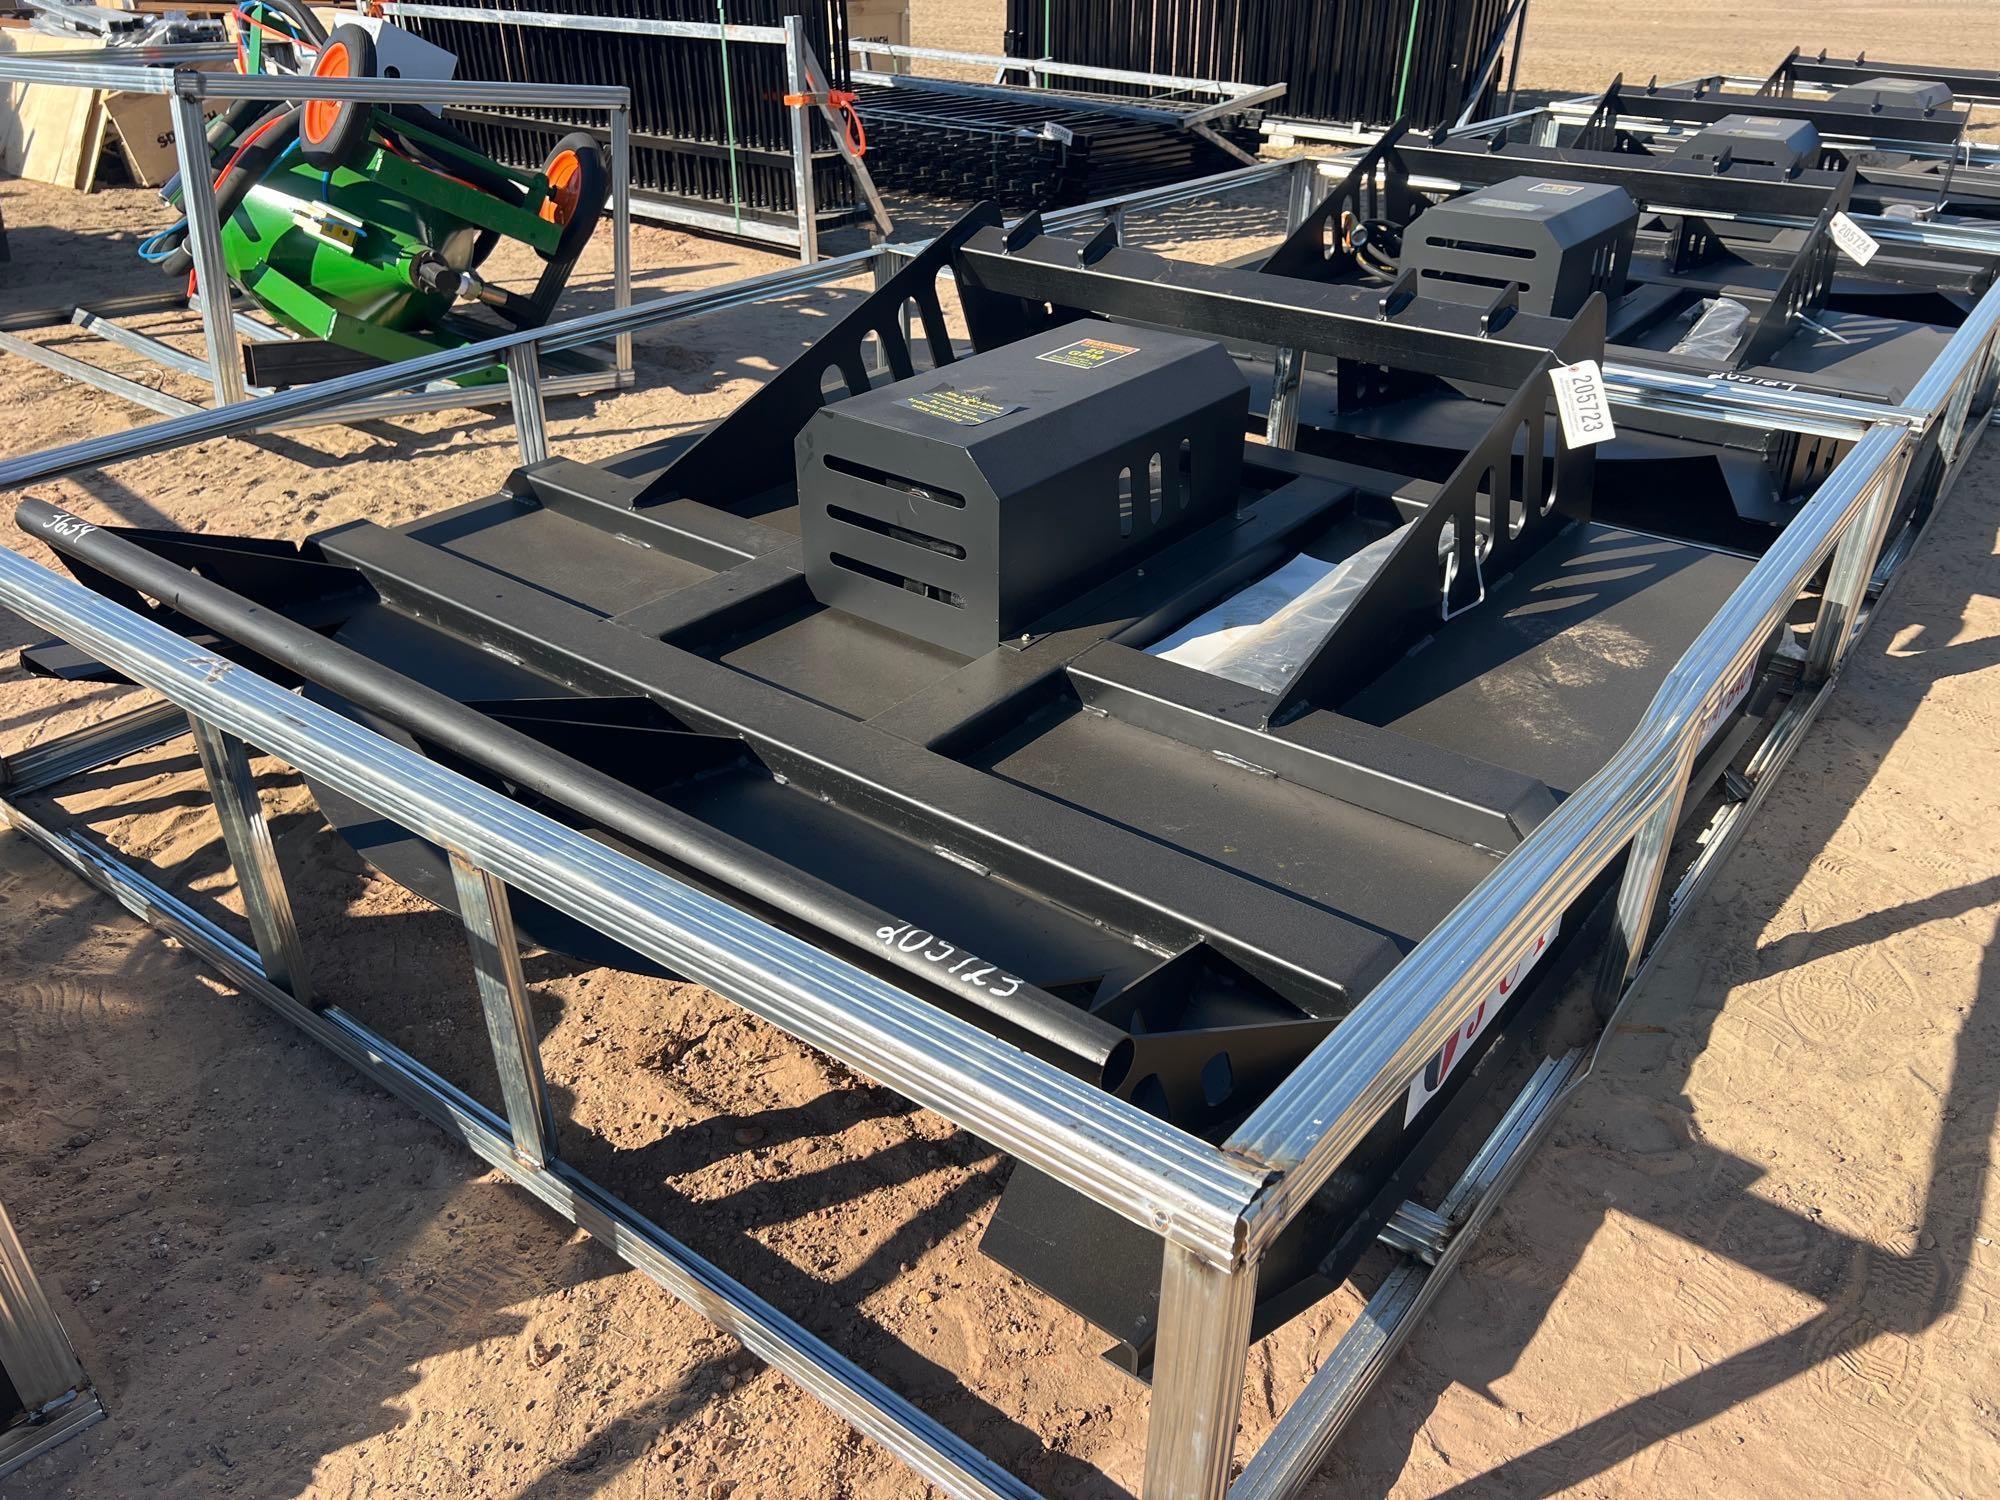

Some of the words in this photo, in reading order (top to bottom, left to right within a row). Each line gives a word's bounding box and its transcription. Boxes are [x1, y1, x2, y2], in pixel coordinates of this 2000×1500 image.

[1838, 223, 1871, 253] 205724
[1068, 350, 1105, 361] GPM
[1572, 374, 1604, 433] 205723
